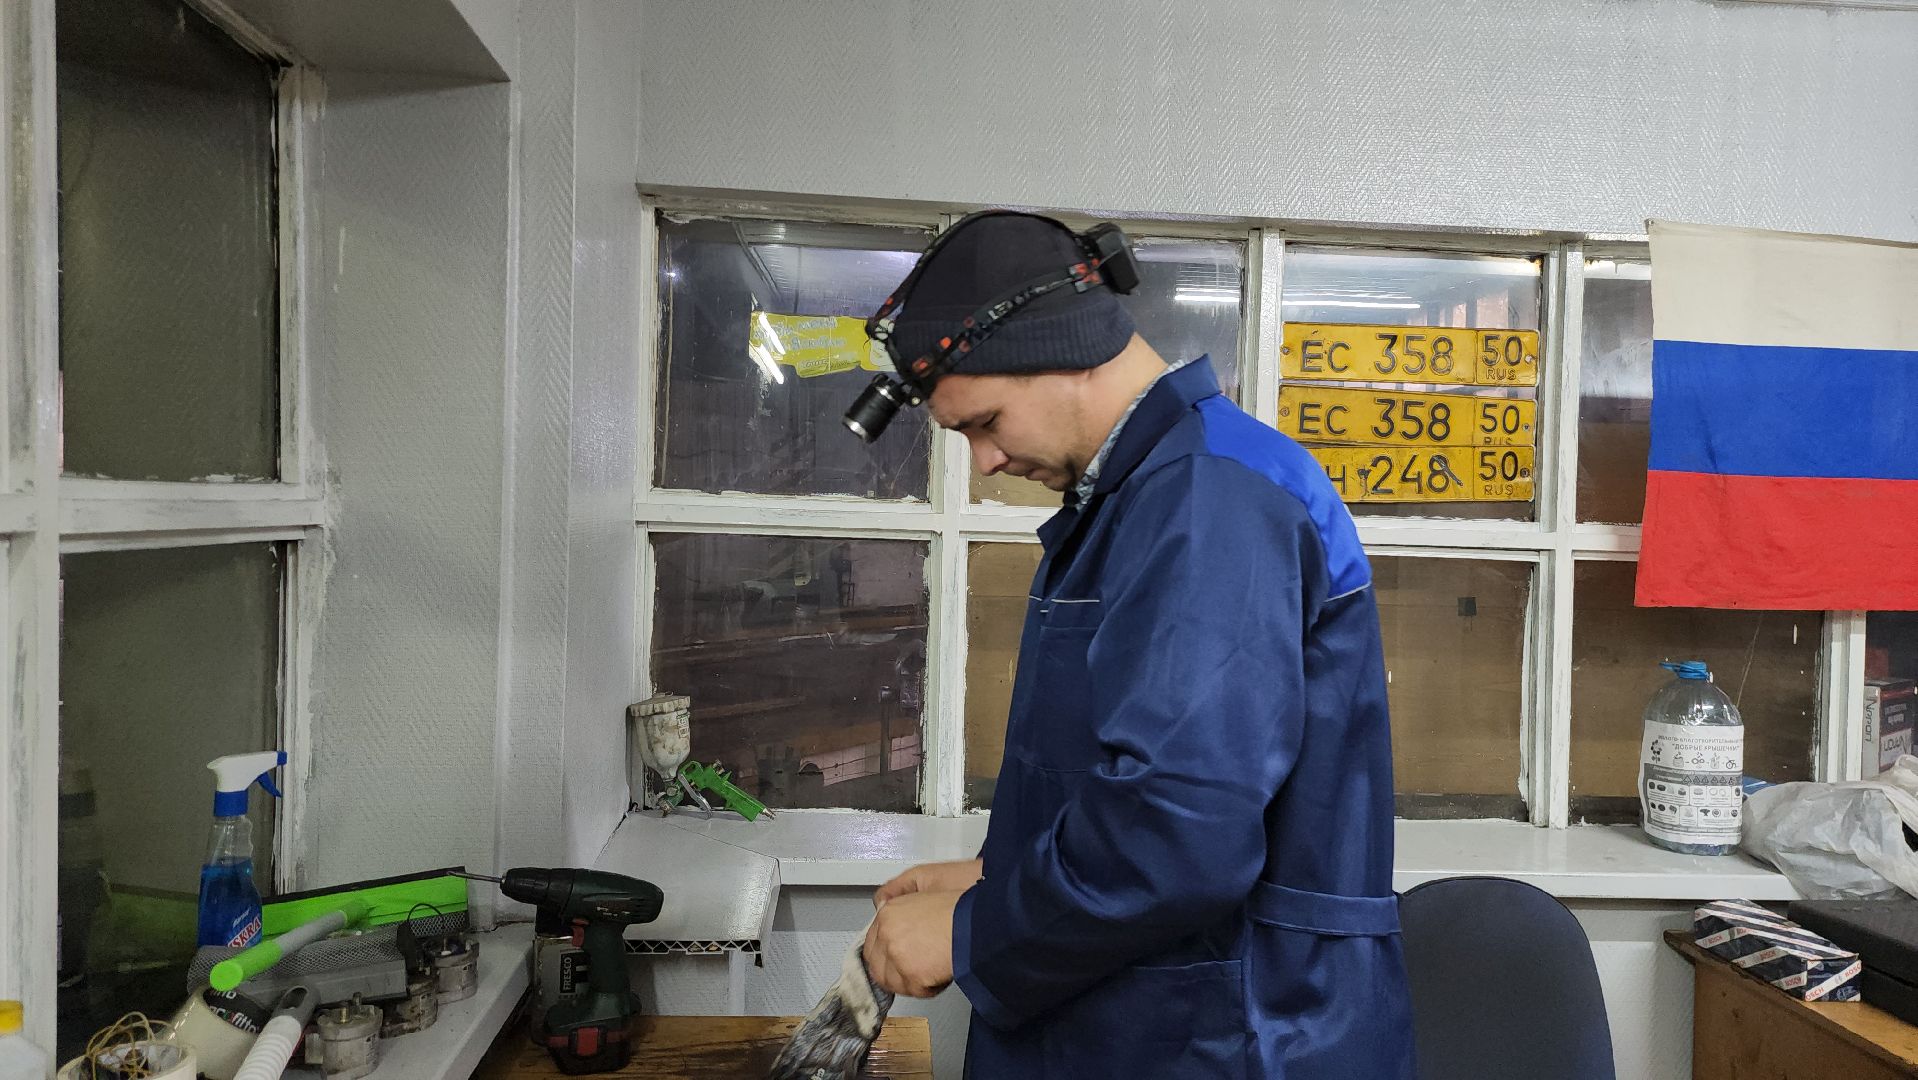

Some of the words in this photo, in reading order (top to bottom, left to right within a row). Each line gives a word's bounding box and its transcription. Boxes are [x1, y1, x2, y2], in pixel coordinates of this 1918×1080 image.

[1373, 333, 1454, 376] 358
[1481, 334, 1523, 367] 50
[1485, 367, 1516, 380] RUS
[1371, 398, 1451, 441] 358
[1479, 403, 1520, 435] 50
[1325, 463, 1347, 496] H
[1370, 454, 1450, 495] 248
[1478, 451, 1519, 482] 50
[1484, 484, 1514, 496] RUS
[562, 956, 573, 991] FRESCO
[1844, 963, 1861, 978] BOSC
[1805, 986, 1825, 1001] OSCH
